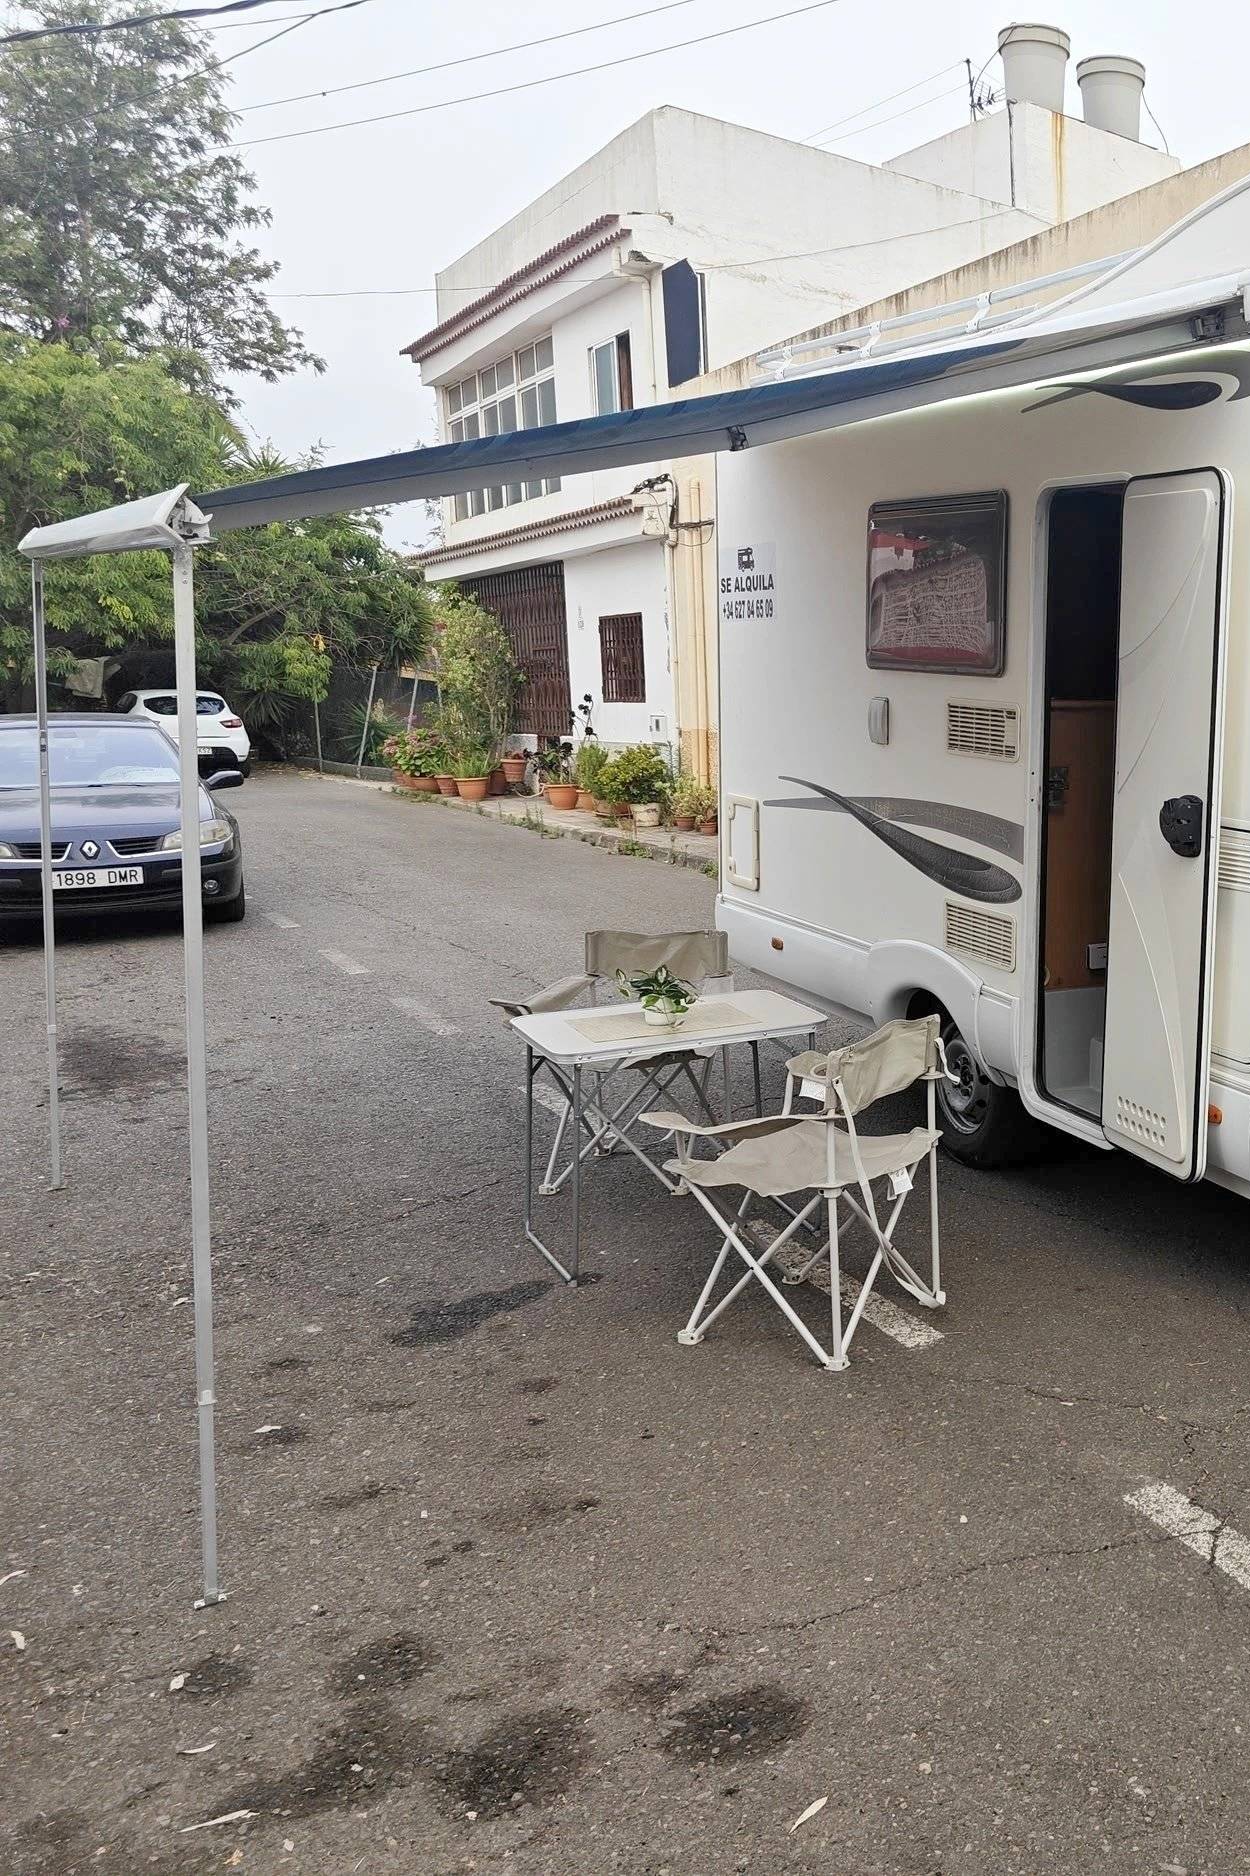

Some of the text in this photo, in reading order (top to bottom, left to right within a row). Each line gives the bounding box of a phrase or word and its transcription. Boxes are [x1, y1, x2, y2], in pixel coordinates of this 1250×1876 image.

[720, 574, 774, 593] SE ALQUILA
[723, 601, 734, 619] +34
[735, 600, 745, 619] 627
[756, 599, 764, 618] 65
[765, 598, 774, 618] 09
[56, 869, 139, 887] 1898 DMR
